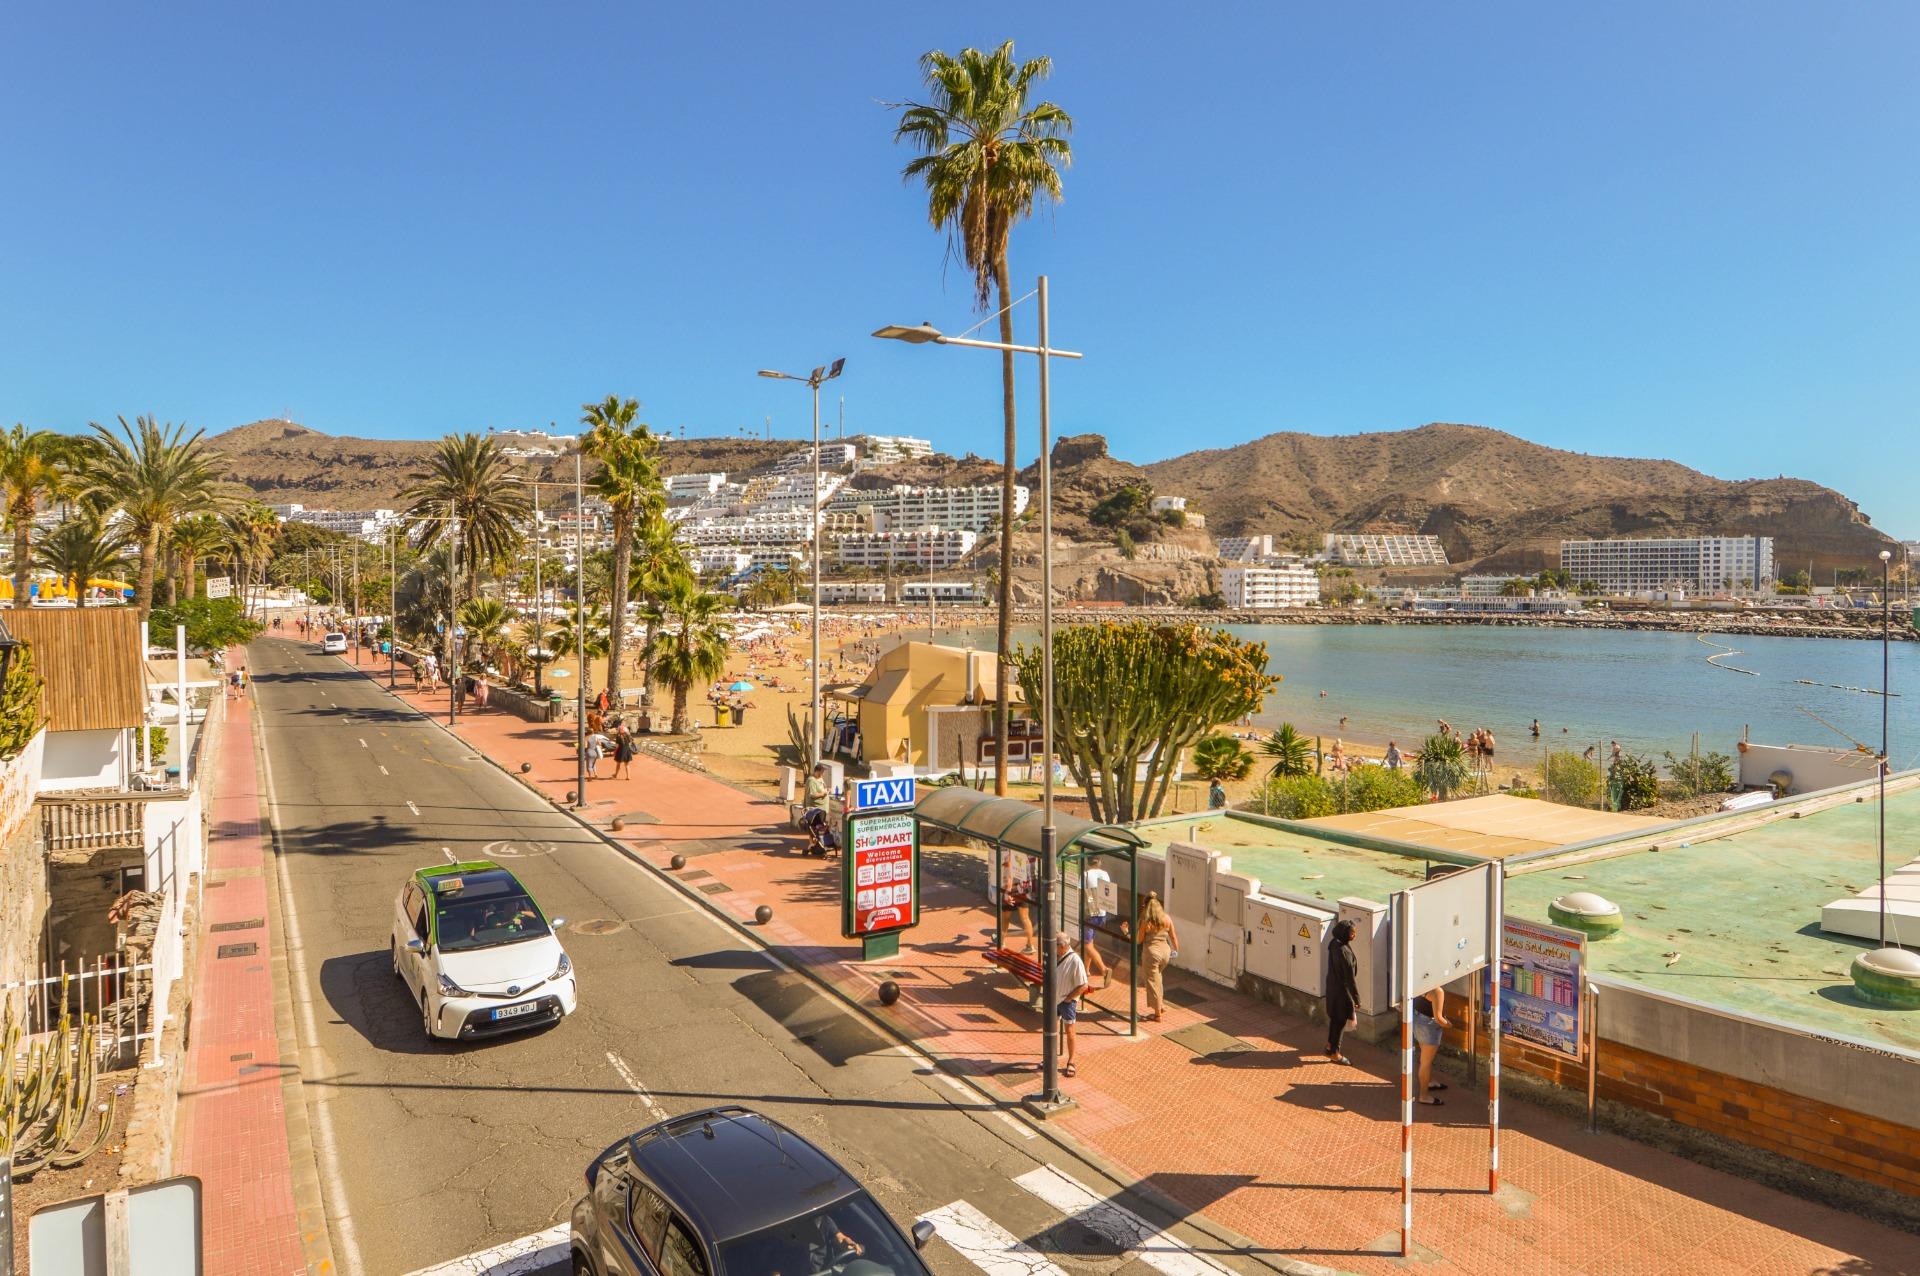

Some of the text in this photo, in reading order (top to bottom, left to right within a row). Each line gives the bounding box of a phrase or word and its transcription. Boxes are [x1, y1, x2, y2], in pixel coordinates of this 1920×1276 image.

[862, 780, 910, 805] TAXI
[860, 815, 908, 826] SUPERMARKET
[857, 821, 911, 833] SUPERMERCADO
[866, 855, 903, 863] Bienvenidos
[867, 849, 902, 859] Welcome
[498, 1004, 535, 1017] 9349 MDJ
